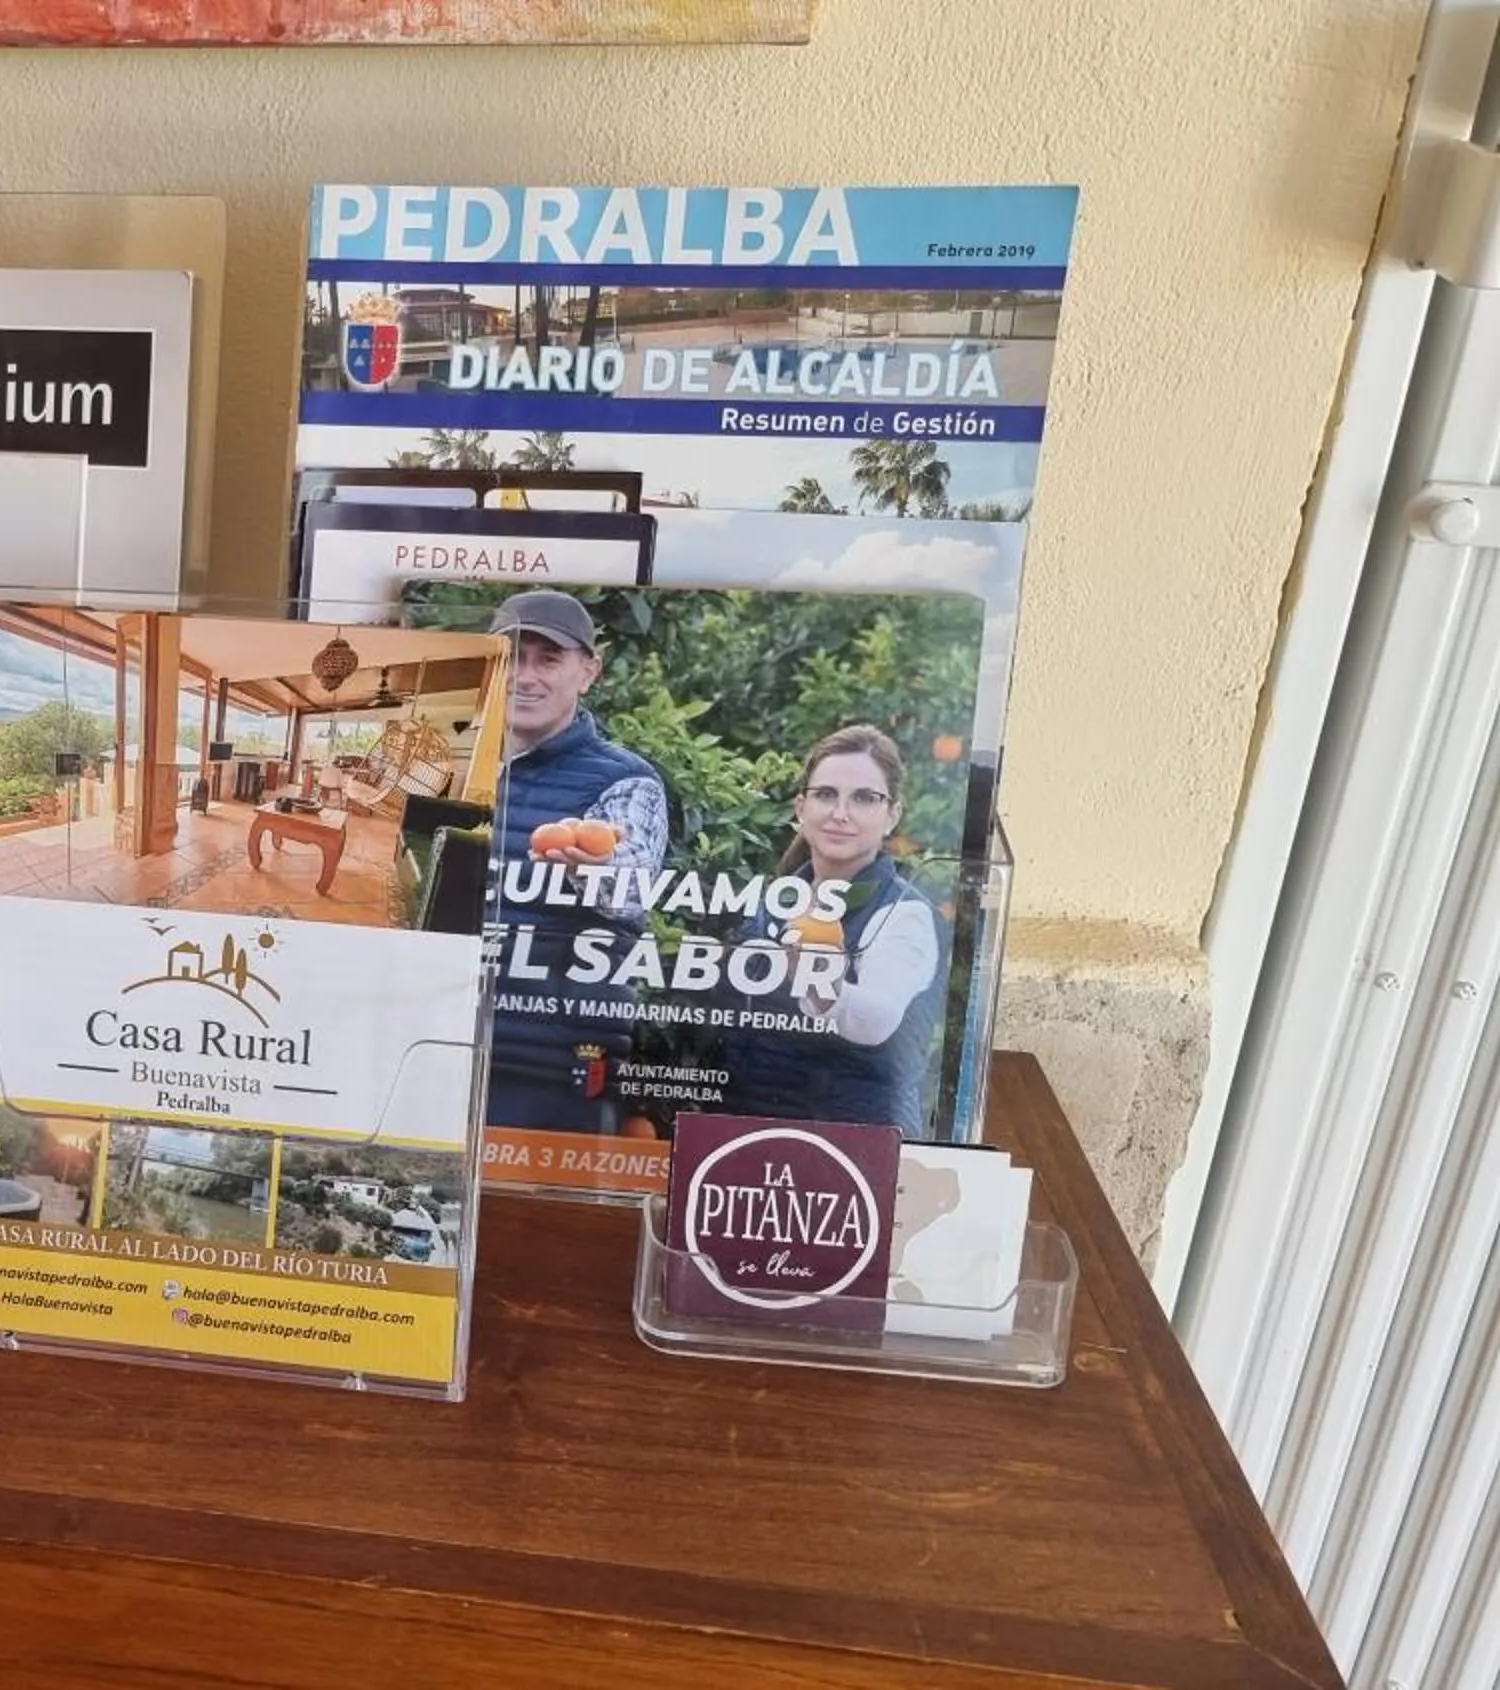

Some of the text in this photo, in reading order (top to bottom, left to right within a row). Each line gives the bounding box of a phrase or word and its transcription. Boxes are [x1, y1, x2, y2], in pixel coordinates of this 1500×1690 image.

[318, 186, 861, 266] PEDRALBA
[927, 242, 1037, 259] Febrero 2019
[449, 340, 1001, 399] DIARIO DE ALCALDÍA
[721, 407, 997, 437] Resumen de Gestión
[395, 545, 550, 573] PEDRALBA
[564, 926, 848, 1001] SABOR
[563, 1000, 576, 1016] Y
[579, 999, 705, 1026] MANDARINAS
[711, 1010, 734, 1028] DE
[739, 1011, 839, 1036] PEDRALBA
[85, 1008, 312, 1067] Casa Rural
[130, 1060, 262, 1096] Buenavista
[617, 1063, 729, 1085] AYUNTAMIENTO
[156, 1091, 231, 1114] Pedralba
[621, 1083, 723, 1103] DE PEDRALBA
[538, 1148, 552, 1167] 3
[560, 1149, 670, 1178] RAZONES
[764, 1162, 794, 1187] LA
[700, 1183, 866, 1249] PITANZA
[39, 1229, 113, 1254] RURAL
[115, 1237, 147, 1257] AL
[152, 1240, 217, 1265] LADO
[222, 1251, 267, 1271] DEL
[272, 1253, 313, 1276] RÍO
[316, 1260, 389, 1285] TURIA
[737, 1249, 816, 1277] se lleva
[1, 1291, 113, 1316] HolaBuenavista
[183, 1285, 415, 1327] hola@buenavistapedralba.com
[188, 1312, 351, 1345] @buenavistapedralba
